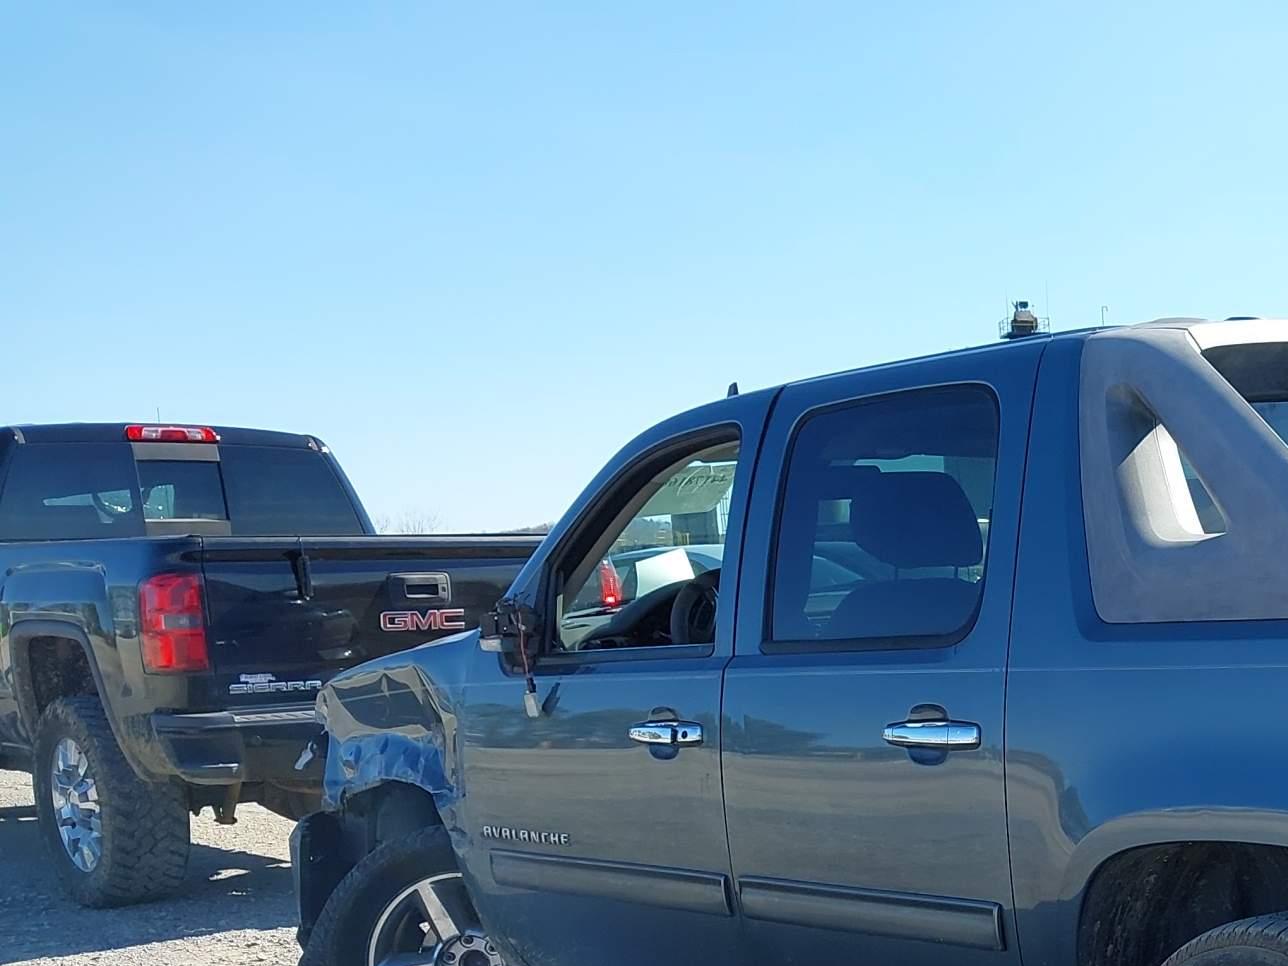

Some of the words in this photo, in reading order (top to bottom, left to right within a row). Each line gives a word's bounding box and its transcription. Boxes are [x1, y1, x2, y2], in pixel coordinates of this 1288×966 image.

[380, 608, 465, 631] GMC
[229, 680, 322, 694] SIERRA
[483, 825, 569, 844] AVALANCHE
